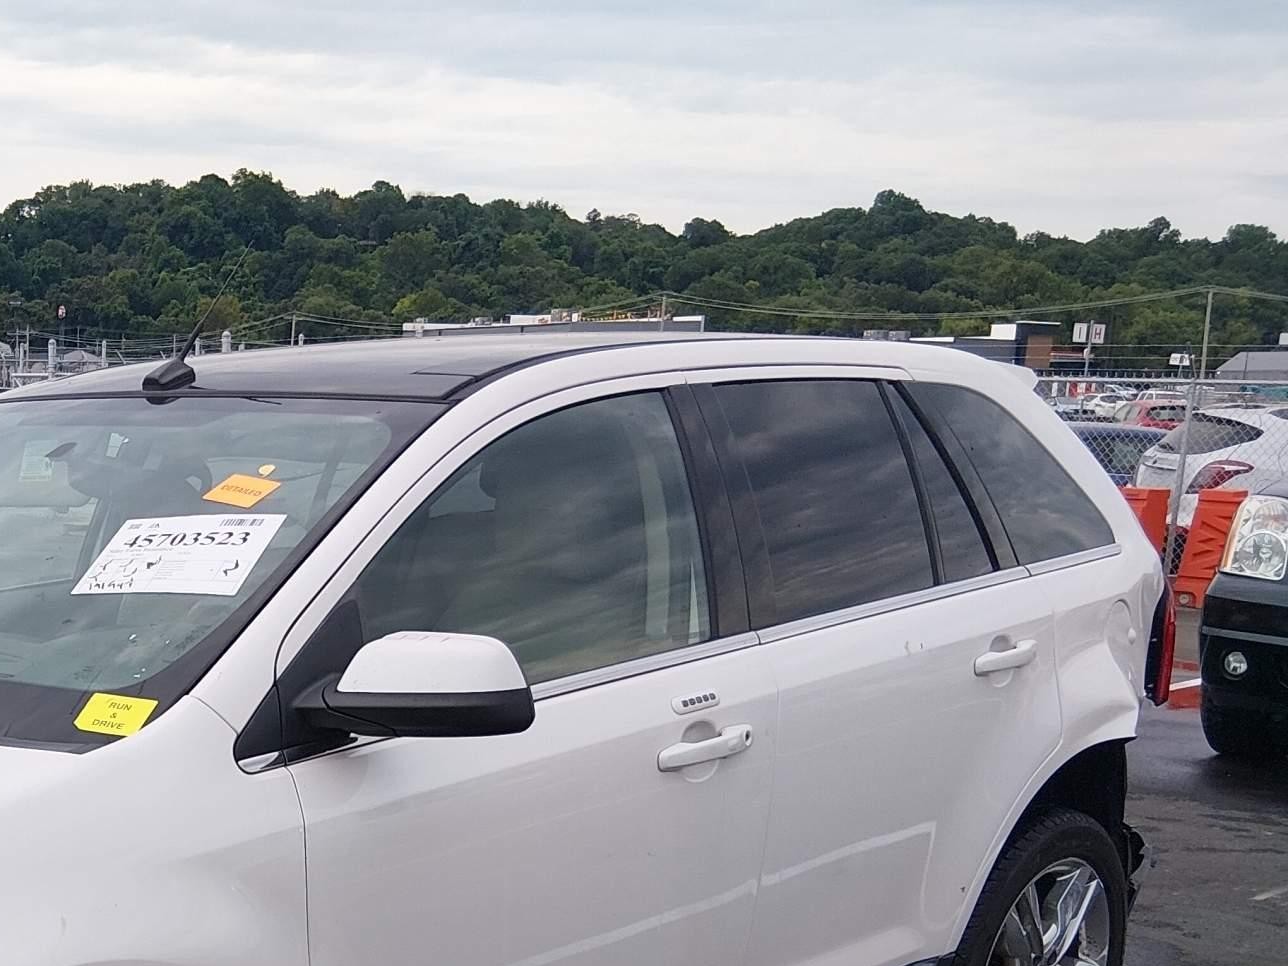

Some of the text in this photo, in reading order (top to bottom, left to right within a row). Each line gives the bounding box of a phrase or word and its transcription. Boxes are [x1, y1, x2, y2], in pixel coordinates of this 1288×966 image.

[220, 484, 263, 497] DETAILED
[123, 531, 251, 548] 45703523
[107, 701, 134, 711] RUN
[91, 718, 127, 730] DRIVE
